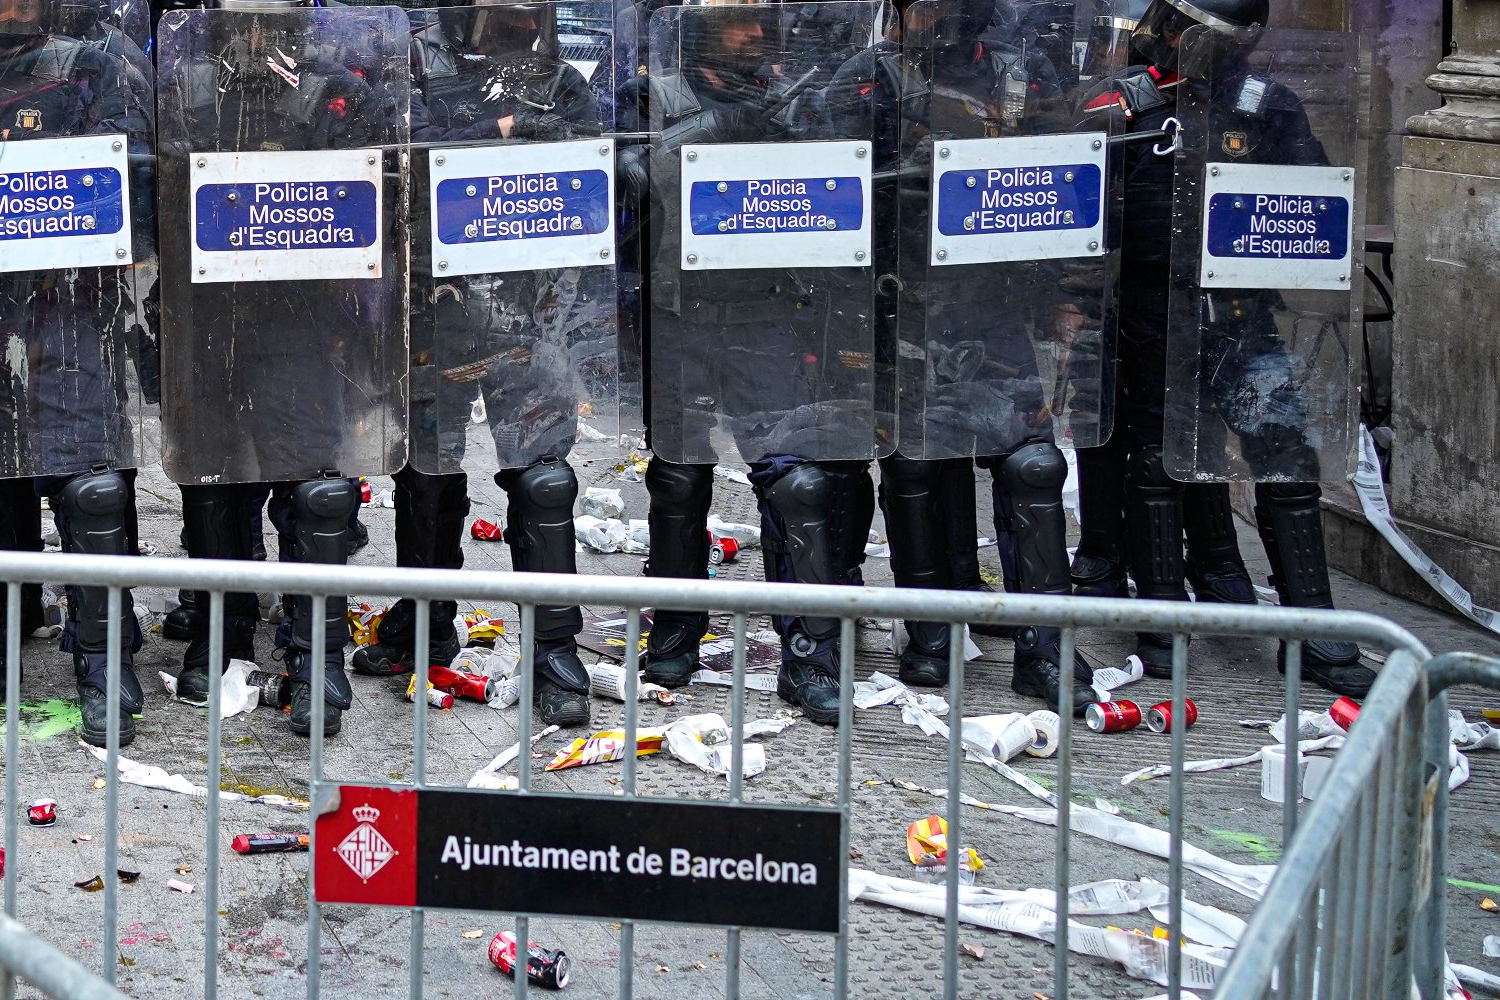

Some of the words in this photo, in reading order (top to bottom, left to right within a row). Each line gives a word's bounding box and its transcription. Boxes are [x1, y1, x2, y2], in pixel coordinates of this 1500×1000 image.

[488, 174, 558, 195] Policia
[747, 180, 806, 195] Policia
[987, 168, 1053, 188] Policia
[255, 182, 329, 202] Policia
[981, 190, 1058, 208] Mossos
[483, 196, 564, 216] Mossos
[742, 197, 811, 212] Mossos
[1256, 195, 1313, 213] Policia
[249, 205, 334, 224] Mossos
[726, 213, 827, 232] d'Esquadra
[1250, 215, 1316, 233] Mossos
[441, 835, 621, 873] Ajuntament
[626, 846, 663, 876] de
[669, 848, 818, 885] Barcelona
